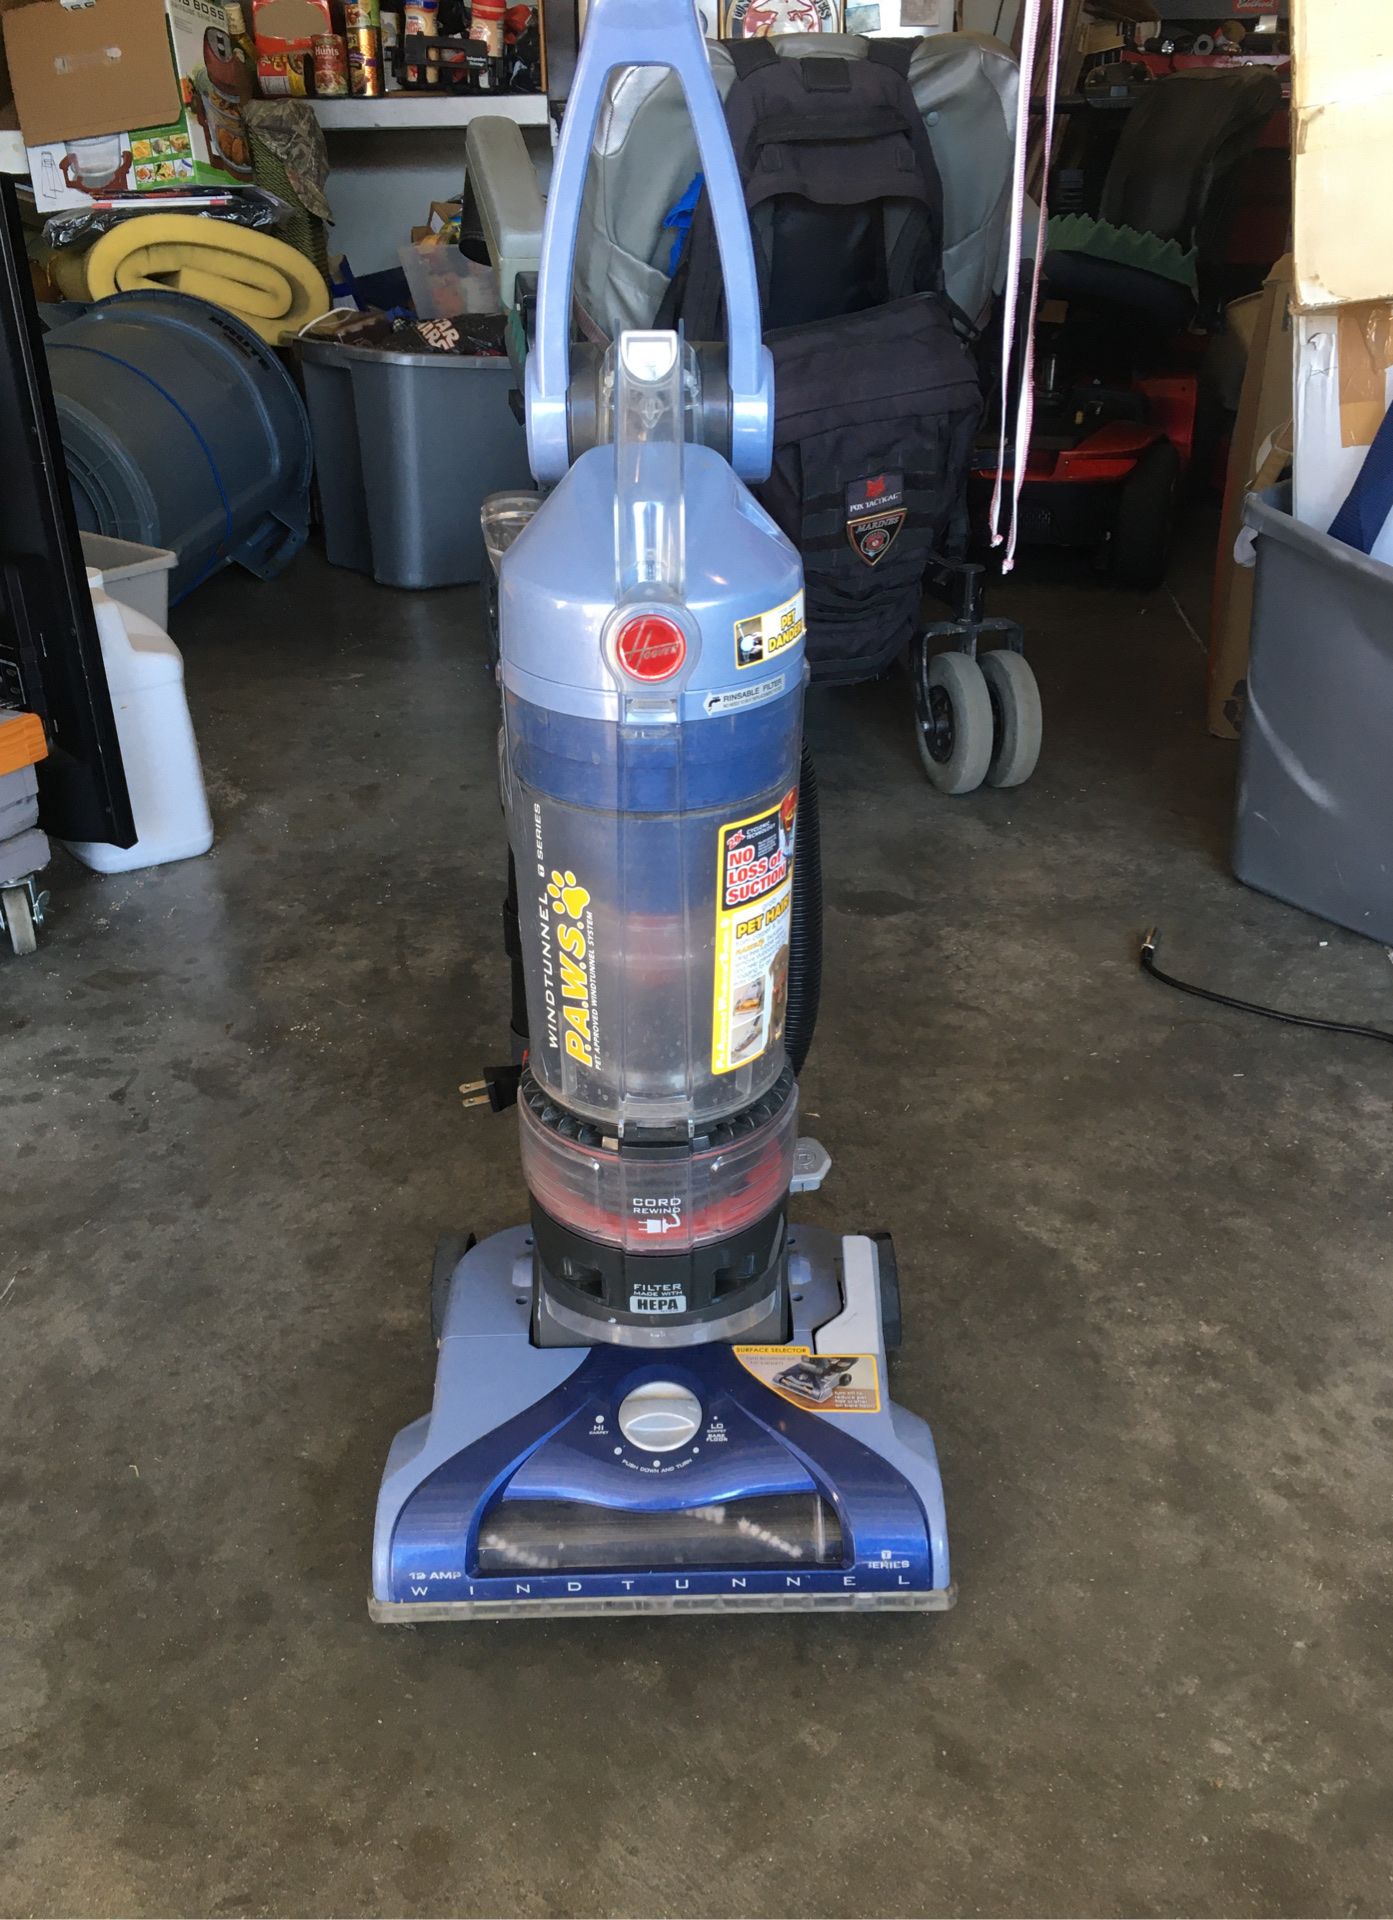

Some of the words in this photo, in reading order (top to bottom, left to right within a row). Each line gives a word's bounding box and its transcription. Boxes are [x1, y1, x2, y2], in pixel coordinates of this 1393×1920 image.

[193, 0, 225, 21] BOSS
[780, 607, 797, 631] PET
[723, 687, 760, 702] RINSABLE
[763, 678, 782, 691] FILTER
[534, 803, 544, 860] SERIES
[728, 846, 754, 868] NO
[728, 858, 768, 886] LOSS
[769, 849, 783, 869] of
[727, 863, 786, 904] SUCTION
[585, 910, 595, 947] SYSTEM
[735, 912, 764, 940] PET
[539, 892, 558, 1048] WINDTUNNEL
[588, 949, 598, 1007] WINDTUNNEL
[591, 1008, 601, 1053] APPROVED
[594, 1053, 602, 1071] PET
[632, 1197, 682, 1207] CORD
[633, 1283, 682, 1292] FILTER
[637, 1298, 679, 1311] HEPA
[621, 1459, 639, 1470] PUSH
[675, 1458, 693, 1469] TURN
[429, 1571, 462, 1579] AMP
